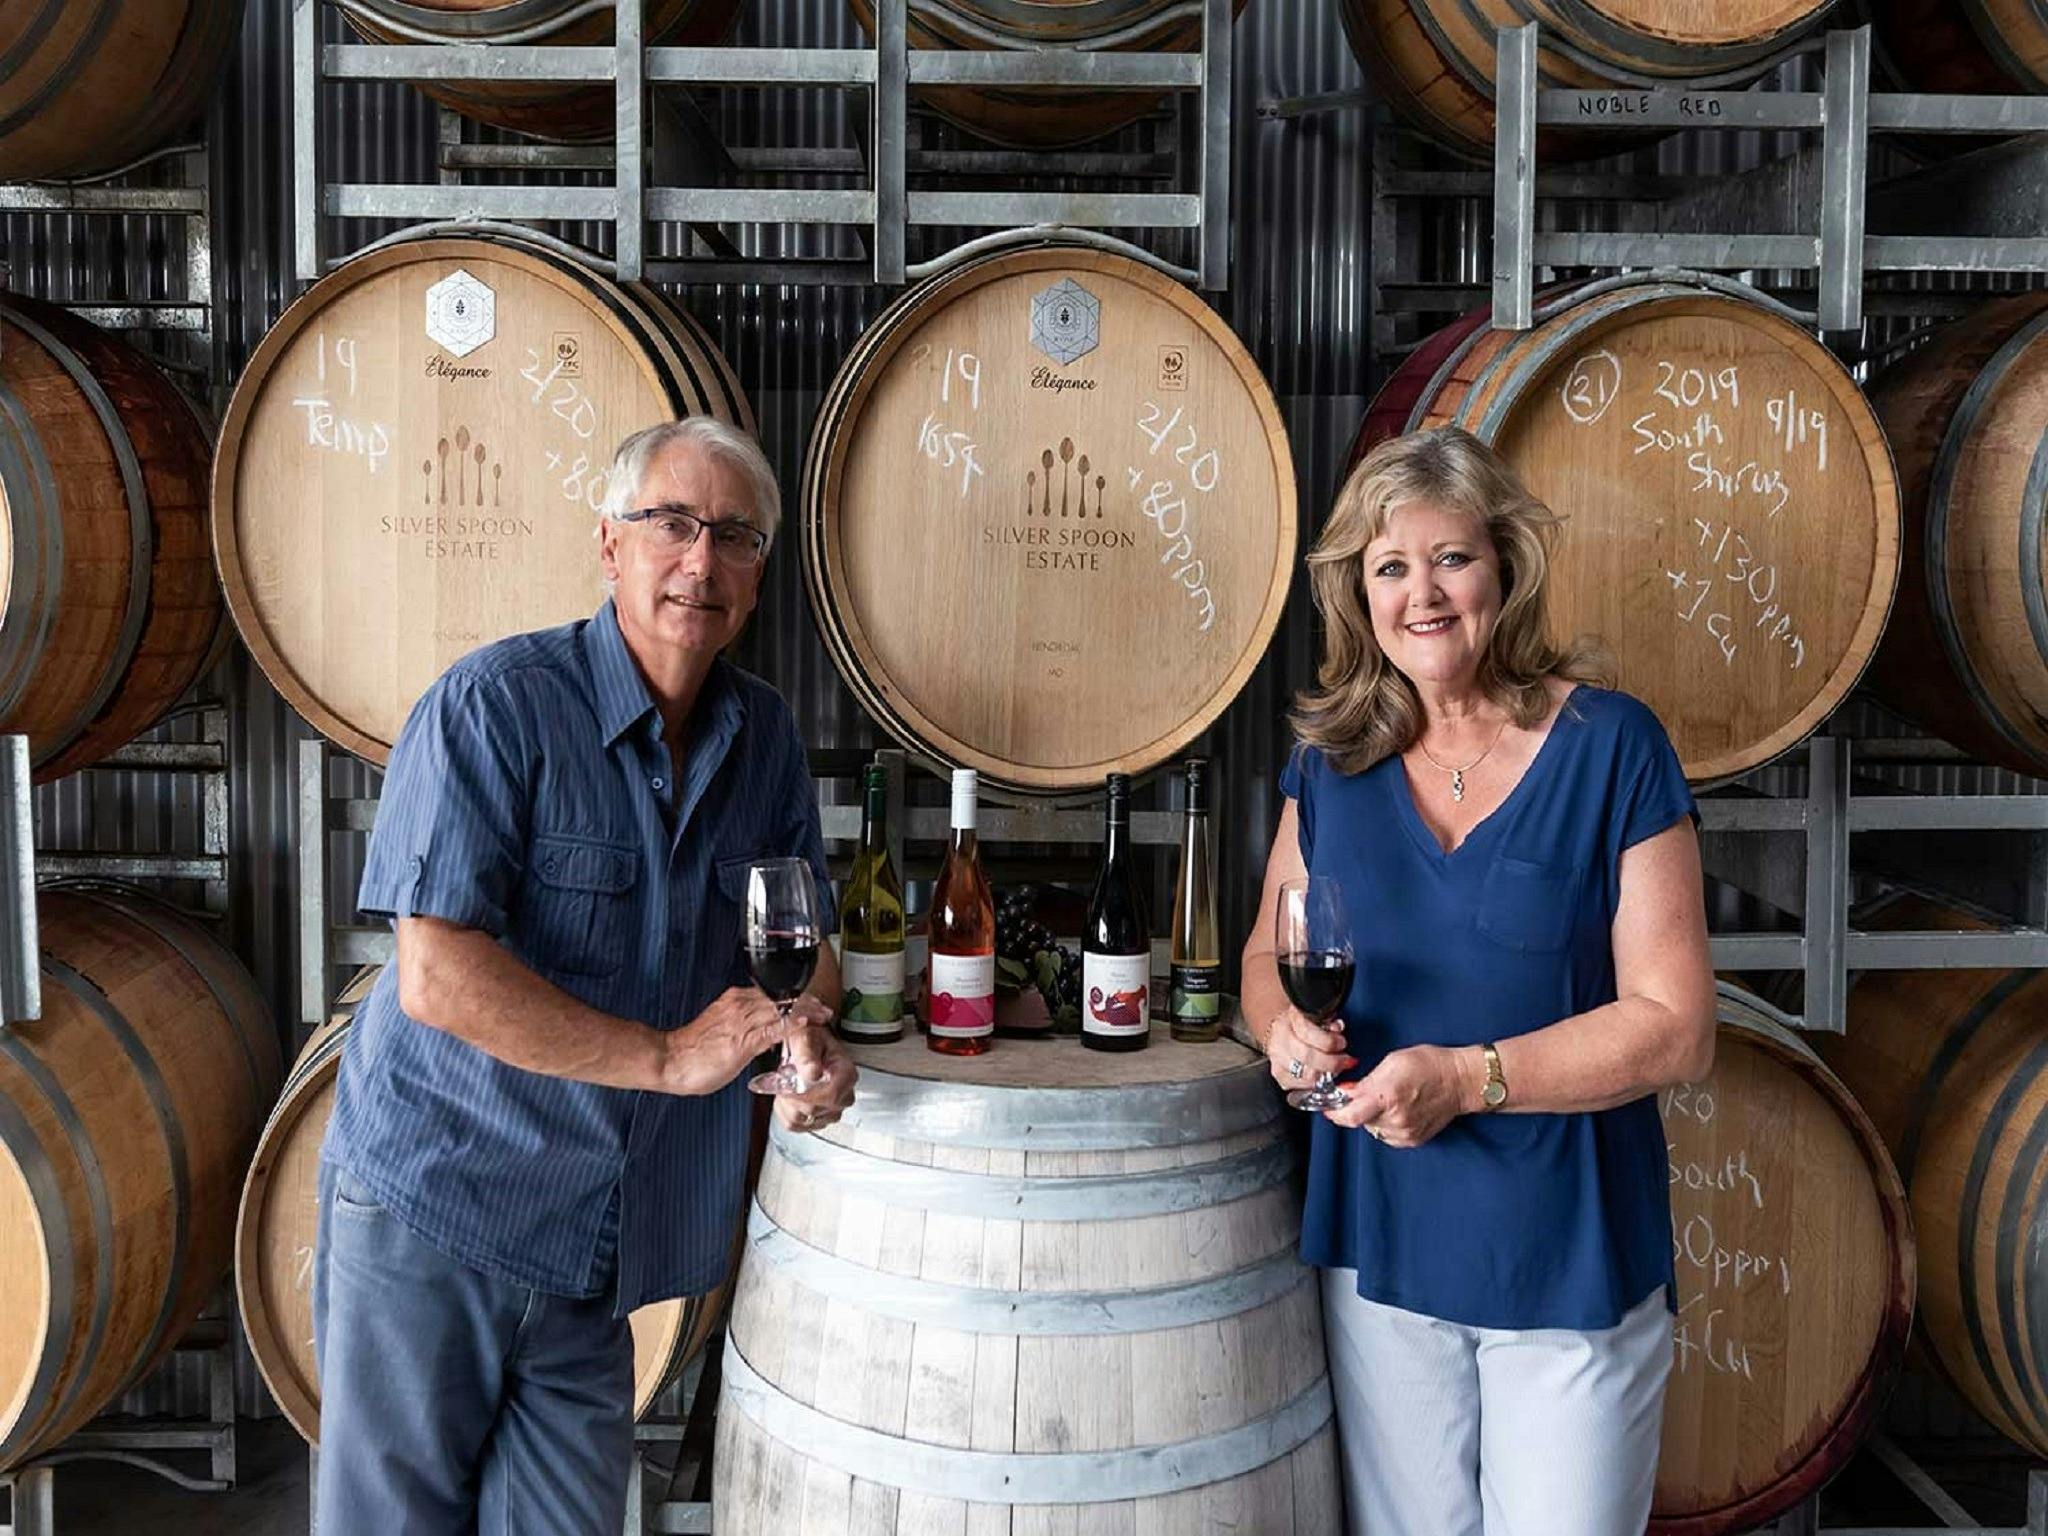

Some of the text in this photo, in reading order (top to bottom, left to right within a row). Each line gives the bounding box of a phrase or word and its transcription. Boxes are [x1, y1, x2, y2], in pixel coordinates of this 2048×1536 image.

[1578, 95, 1722, 116] NOBLE RED
[318, 333, 357, 397] 19
[942, 349, 980, 410] 19
[1653, 361, 1738, 408] 2019
[292, 399, 389, 473] Temp
[1632, 411, 1724, 455] South
[1766, 390, 1828, 471] 9/19
[381, 515, 534, 536] SILVER SPOON
[983, 526, 1135, 548] SILVER SPOON
[425, 540, 499, 560] ESTATE
[1026, 551, 1100, 571] ESTATE
